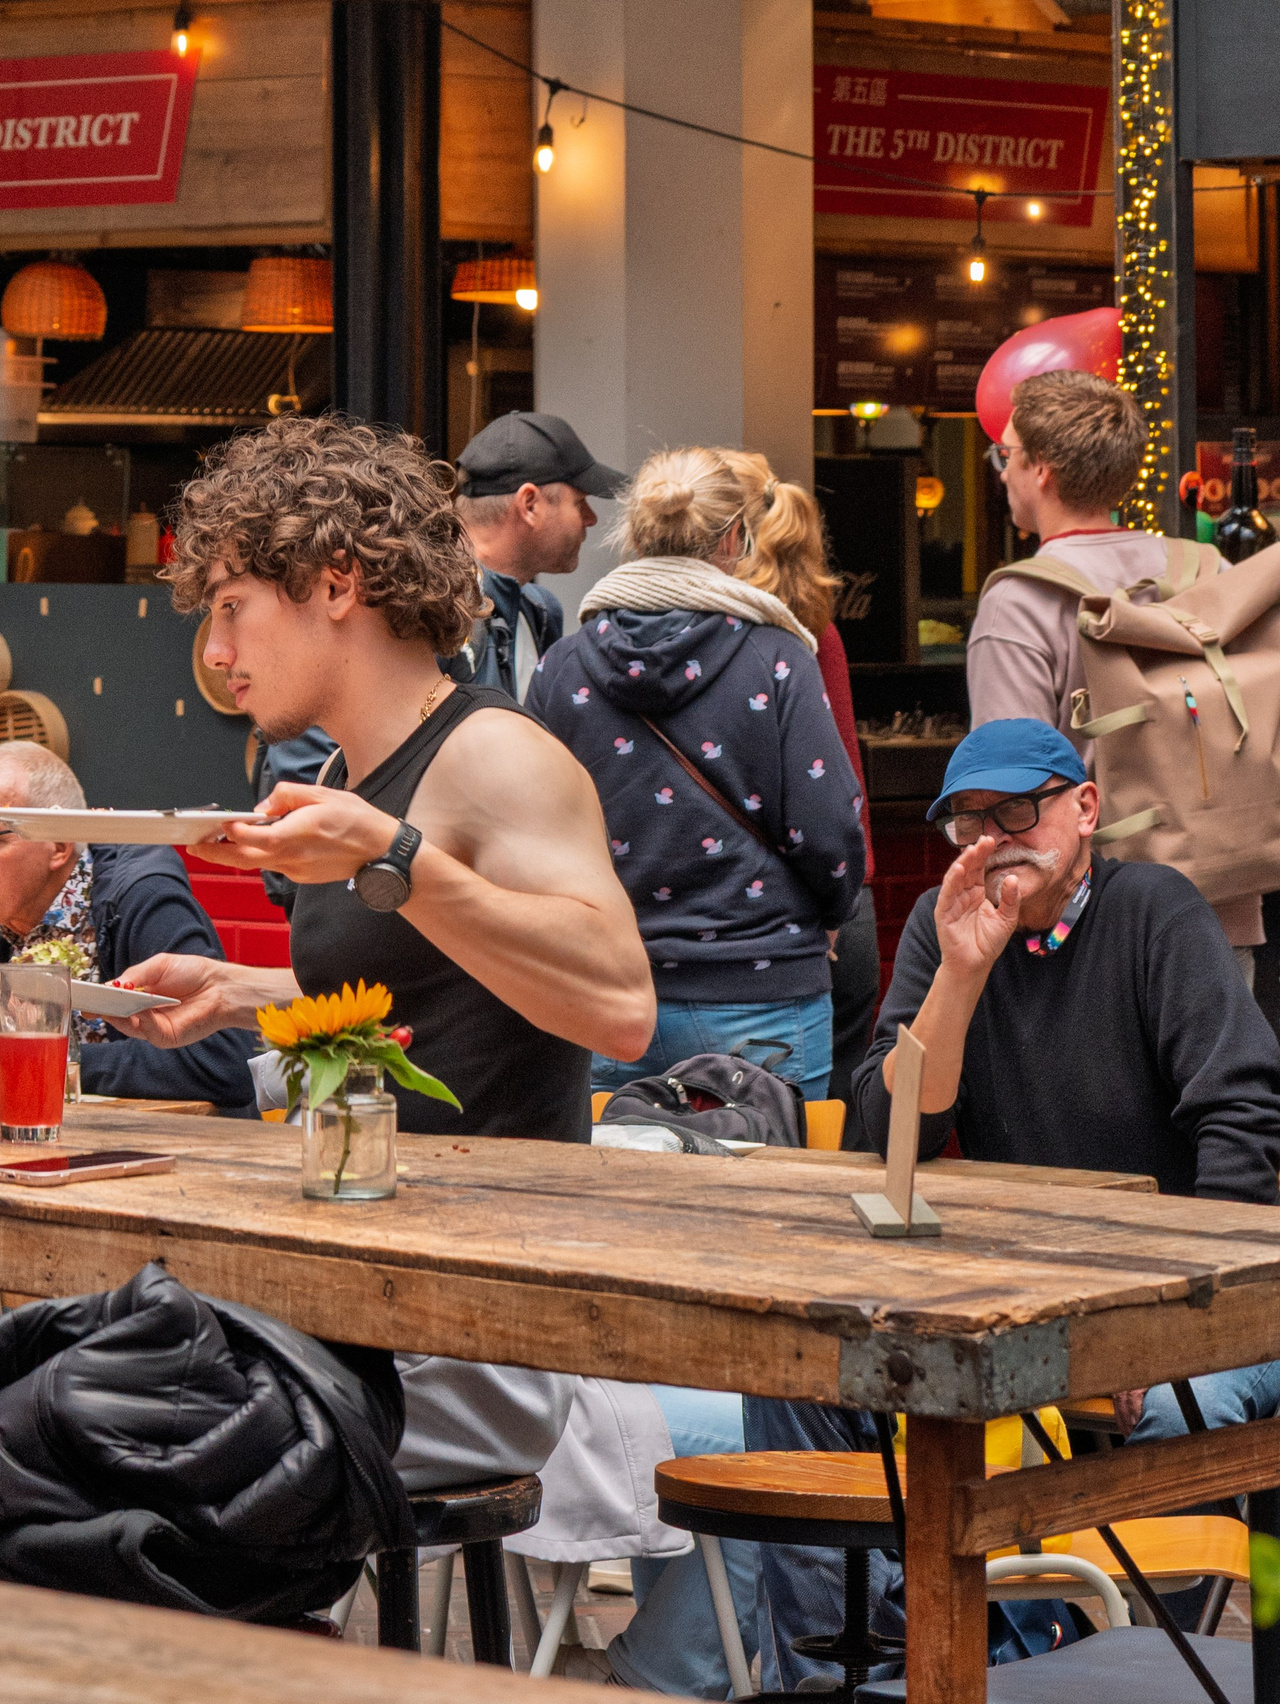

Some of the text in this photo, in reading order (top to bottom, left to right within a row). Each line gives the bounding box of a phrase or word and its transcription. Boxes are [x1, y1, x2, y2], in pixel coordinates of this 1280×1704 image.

[826, 123, 1065, 170] THE 5TH DISTRICT
